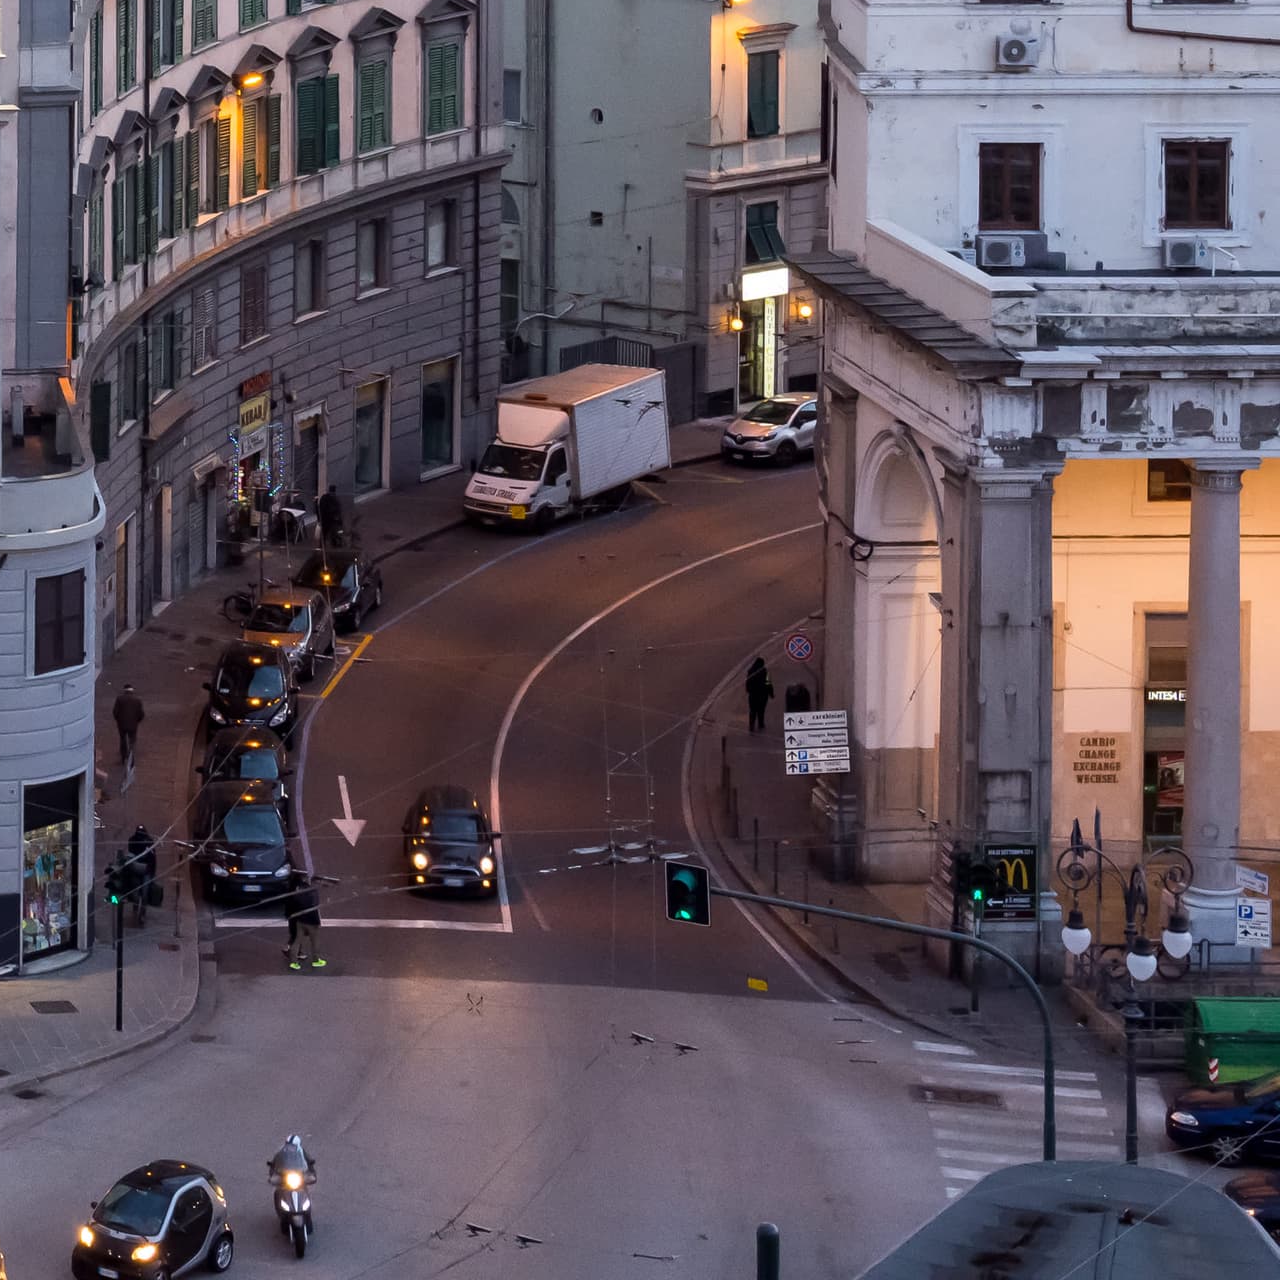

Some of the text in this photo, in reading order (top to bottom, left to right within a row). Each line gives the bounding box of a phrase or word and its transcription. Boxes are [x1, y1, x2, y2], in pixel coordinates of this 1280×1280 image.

[1148, 691, 1178, 701] INTESA
[1080, 738, 1116, 747] CAMBIO
[1079, 750, 1117, 759] CHANGE
[1073, 762, 1121, 771] EXCHANGE
[1076, 774, 1120, 784] WECHSEL
